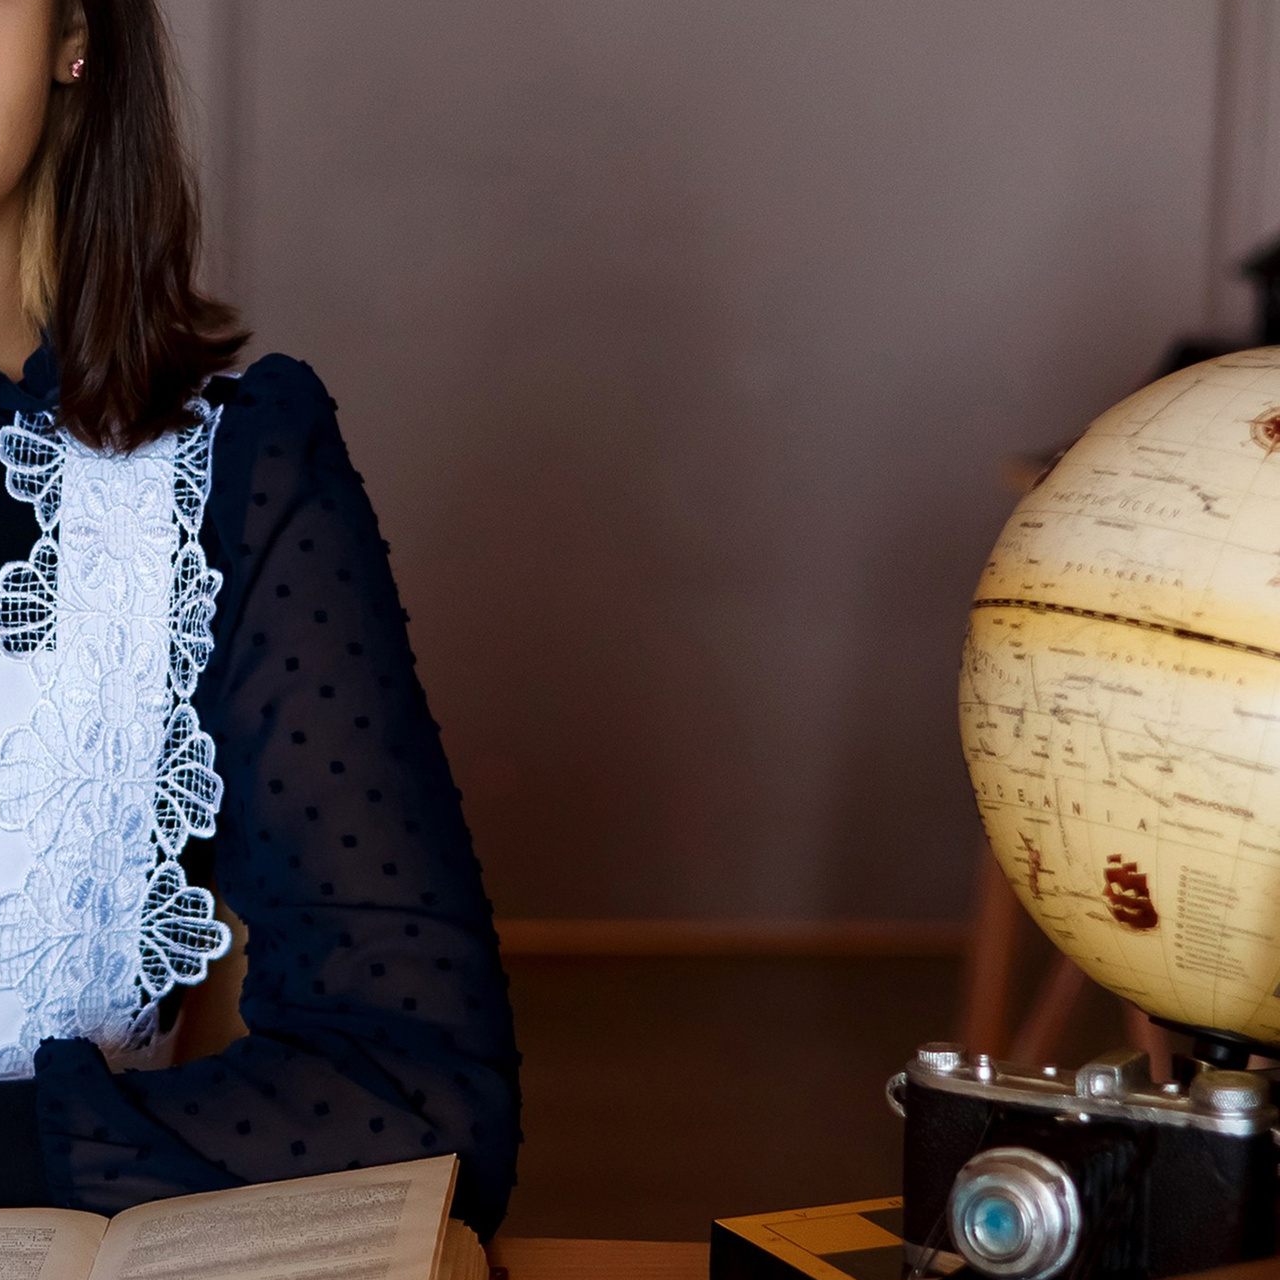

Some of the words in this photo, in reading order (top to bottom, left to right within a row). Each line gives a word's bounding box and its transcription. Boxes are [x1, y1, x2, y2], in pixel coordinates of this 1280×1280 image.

[1119, 498, 1182, 519] OCEAN
[1062, 560, 1184, 588] POLYNESIA
[1110, 651, 1245, 686] POLYNESIA
[980, 781, 1147, 832] OCEANIA
